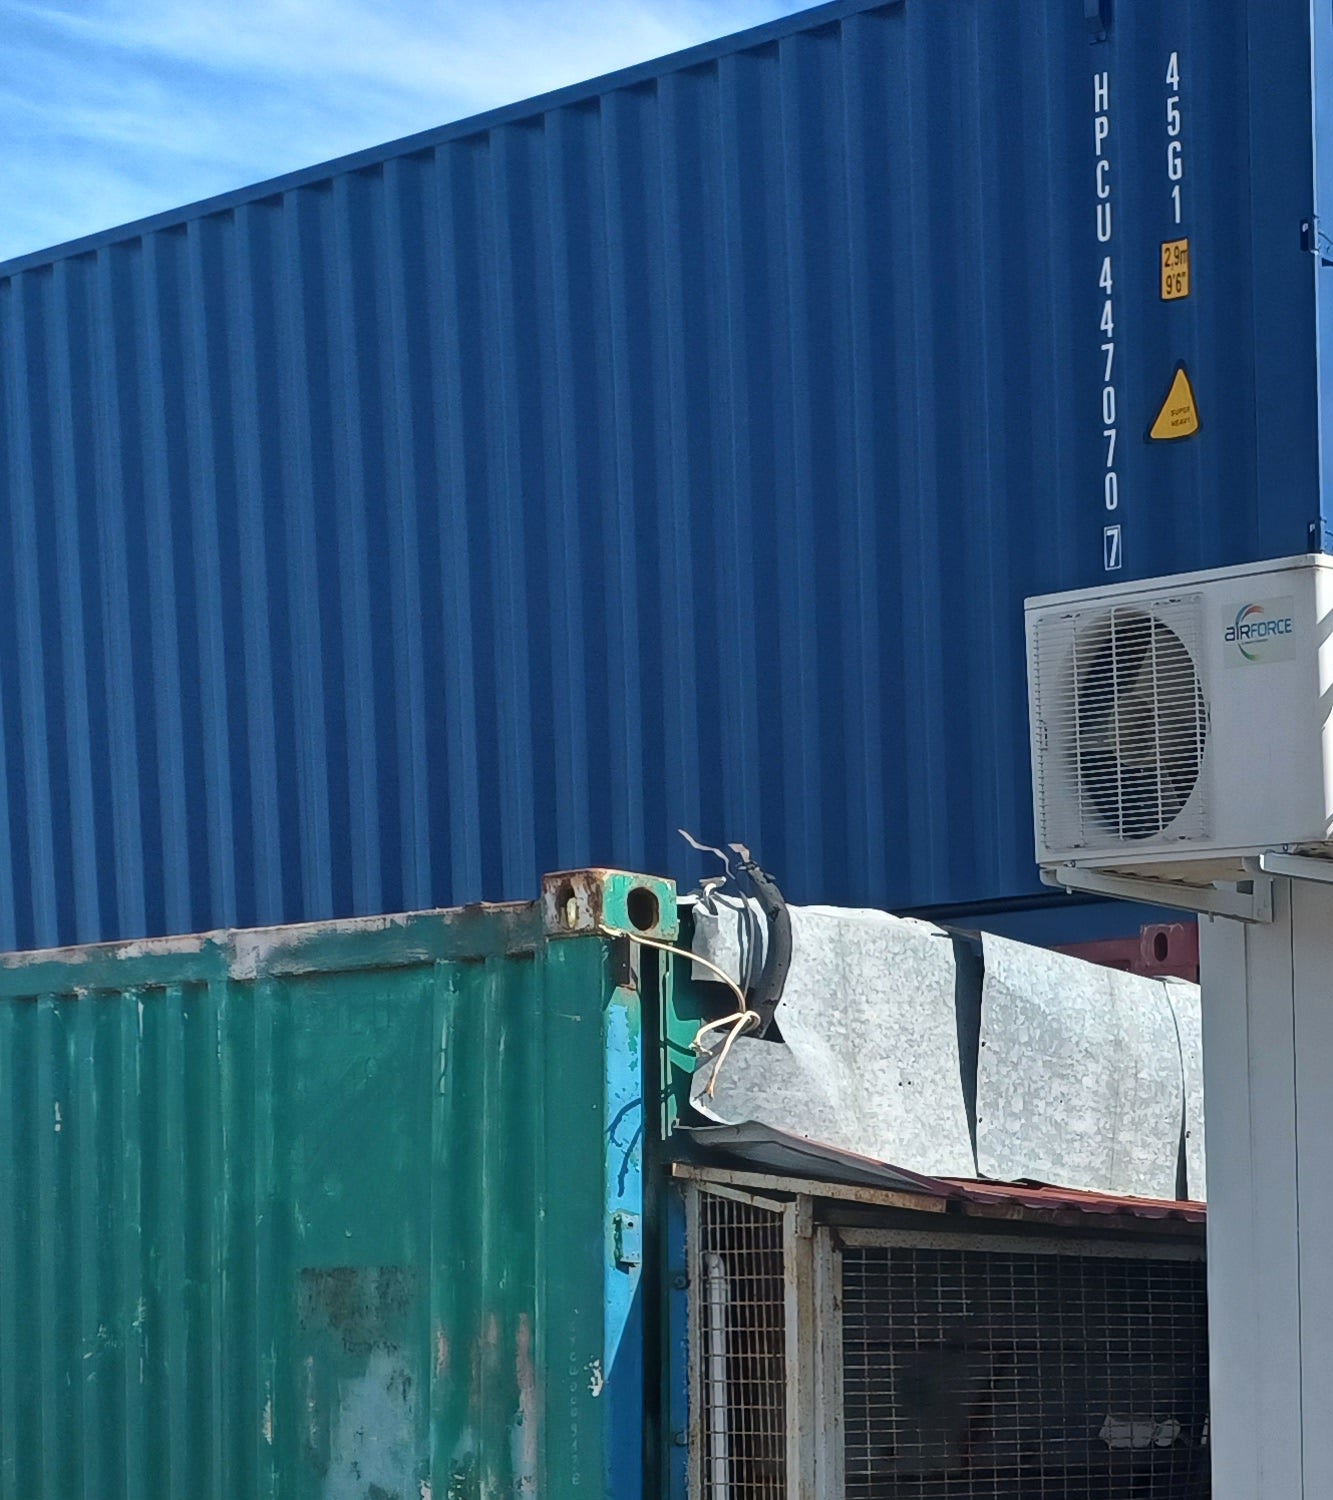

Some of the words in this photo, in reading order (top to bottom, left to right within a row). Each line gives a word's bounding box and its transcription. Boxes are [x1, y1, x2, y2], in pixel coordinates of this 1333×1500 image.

[1093, 72, 1112, 243] HPCU
[1166, 52, 1182, 223] 45G1
[1099, 256, 1119, 511] 447070
[1106, 527, 1119, 566] 7
